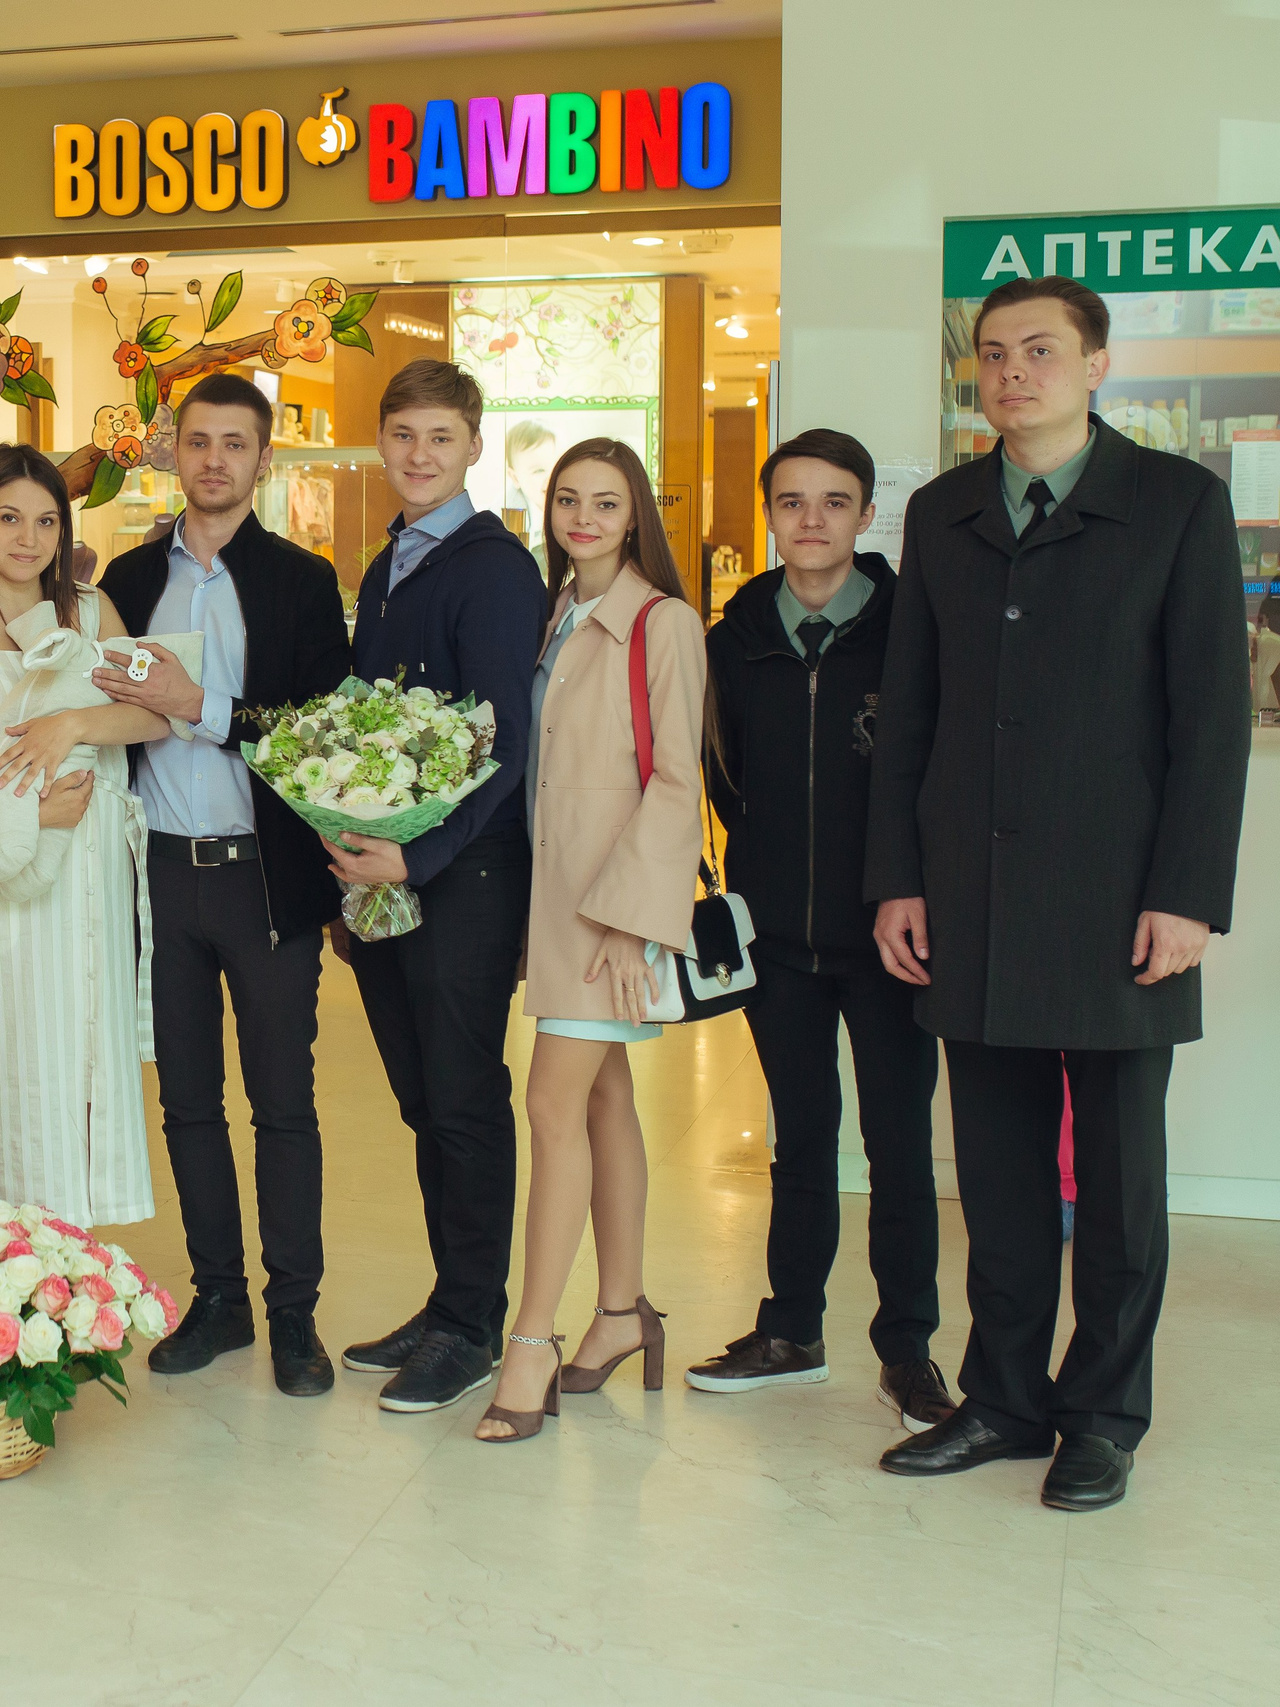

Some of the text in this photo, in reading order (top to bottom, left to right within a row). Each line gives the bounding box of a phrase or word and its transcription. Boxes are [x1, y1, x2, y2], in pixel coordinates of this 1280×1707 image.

[53, 82, 731, 218] BOSCO BAMBINO
[981, 224, 1280, 281] АПТЕКА
